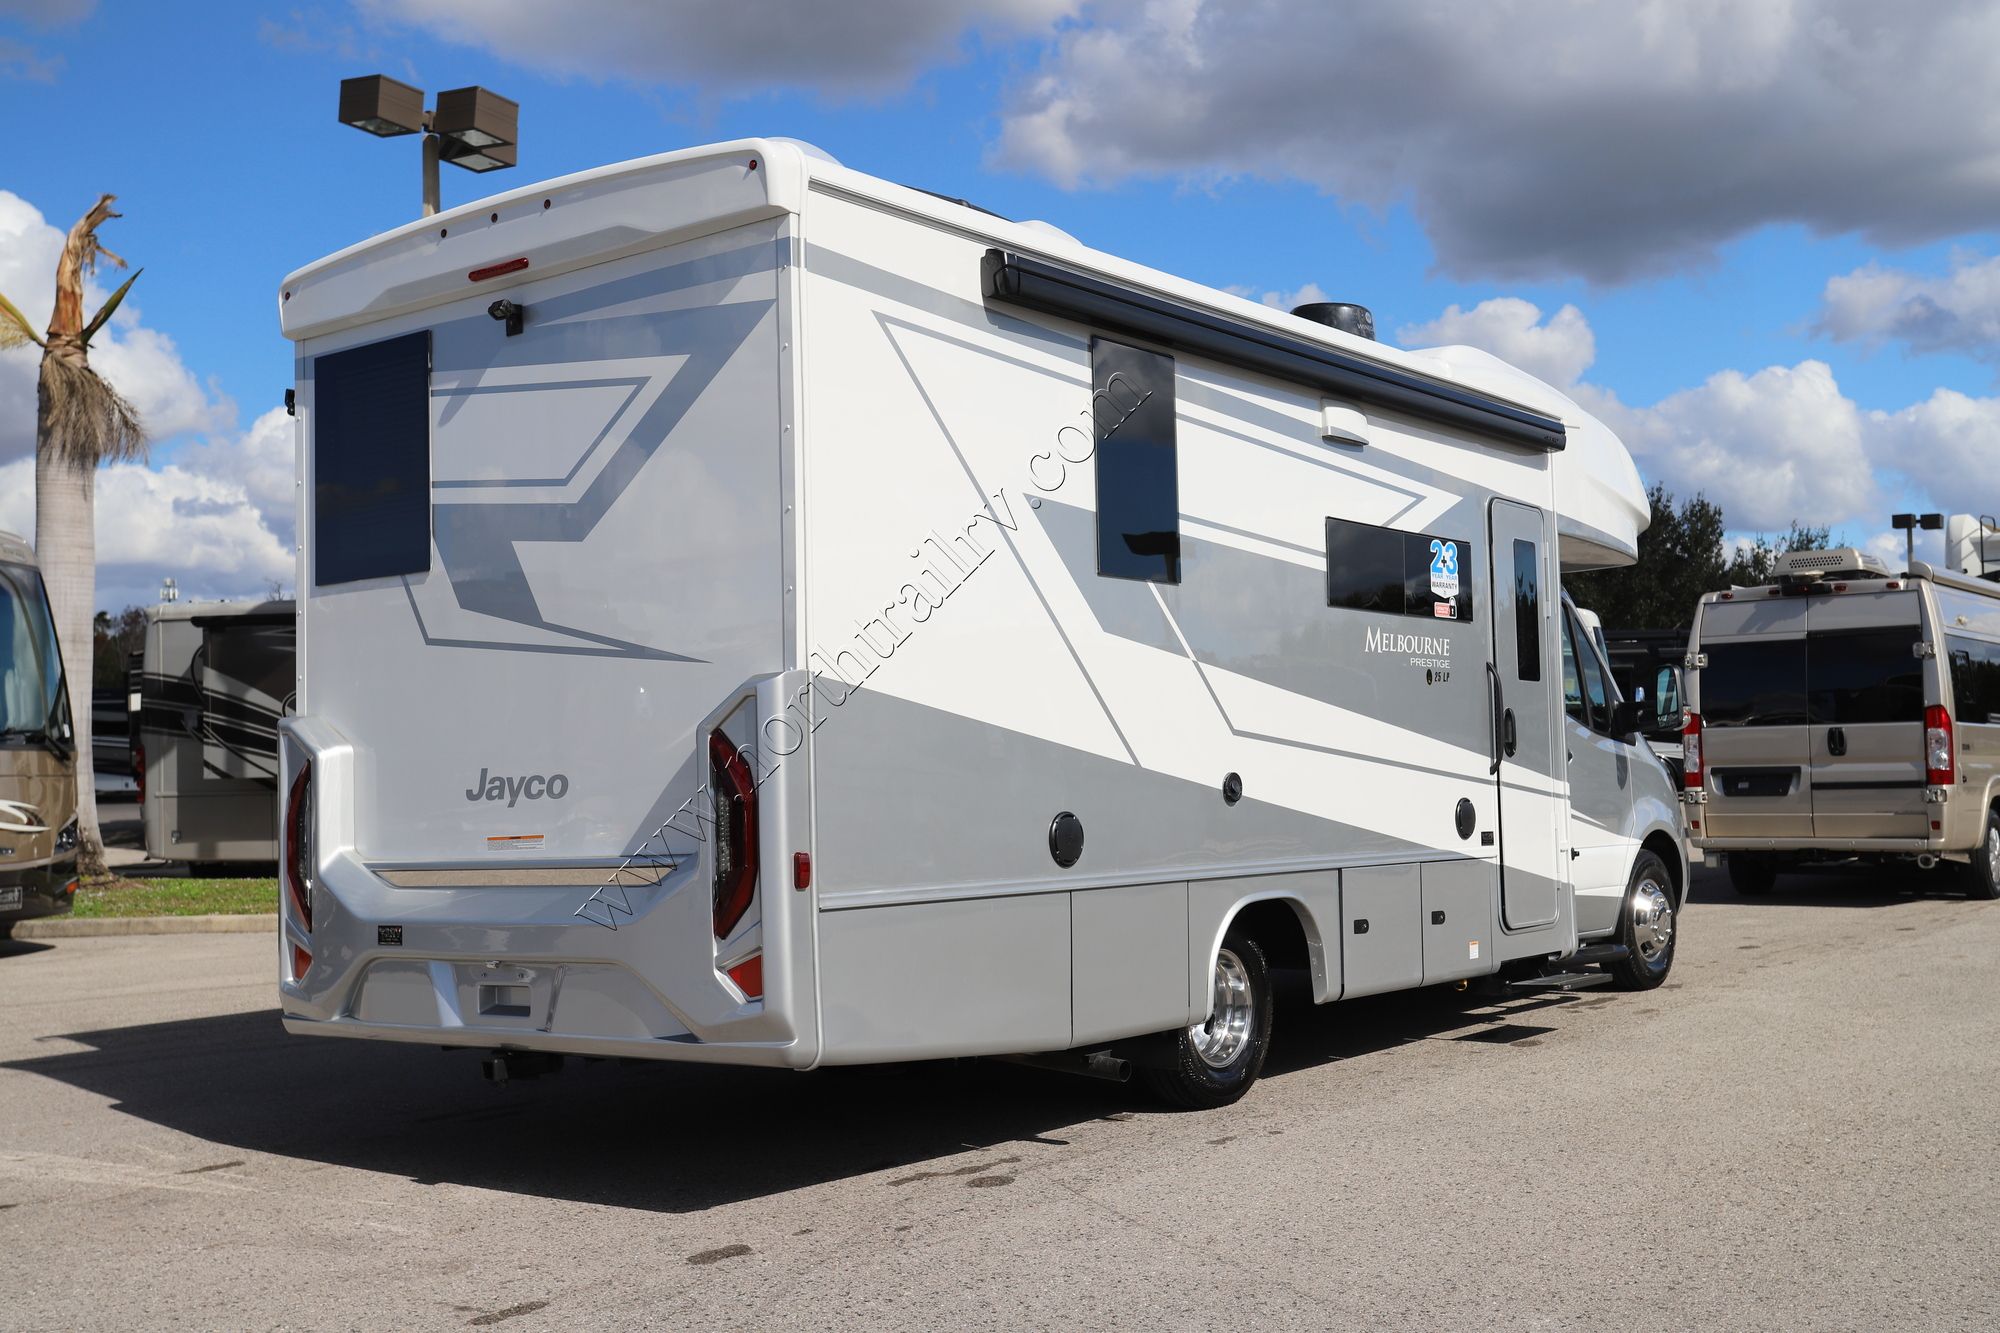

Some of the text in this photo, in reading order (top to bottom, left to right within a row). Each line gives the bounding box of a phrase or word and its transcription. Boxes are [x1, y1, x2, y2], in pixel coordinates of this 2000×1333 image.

[1432, 581, 1457, 590] WARRANTY
[1364, 625, 1450, 656] MELBOURNE
[1410, 657, 1451, 669] PRESTIGE
[1434, 671, 1450, 682] 25 LP
[465, 767, 569, 808] Jayco
